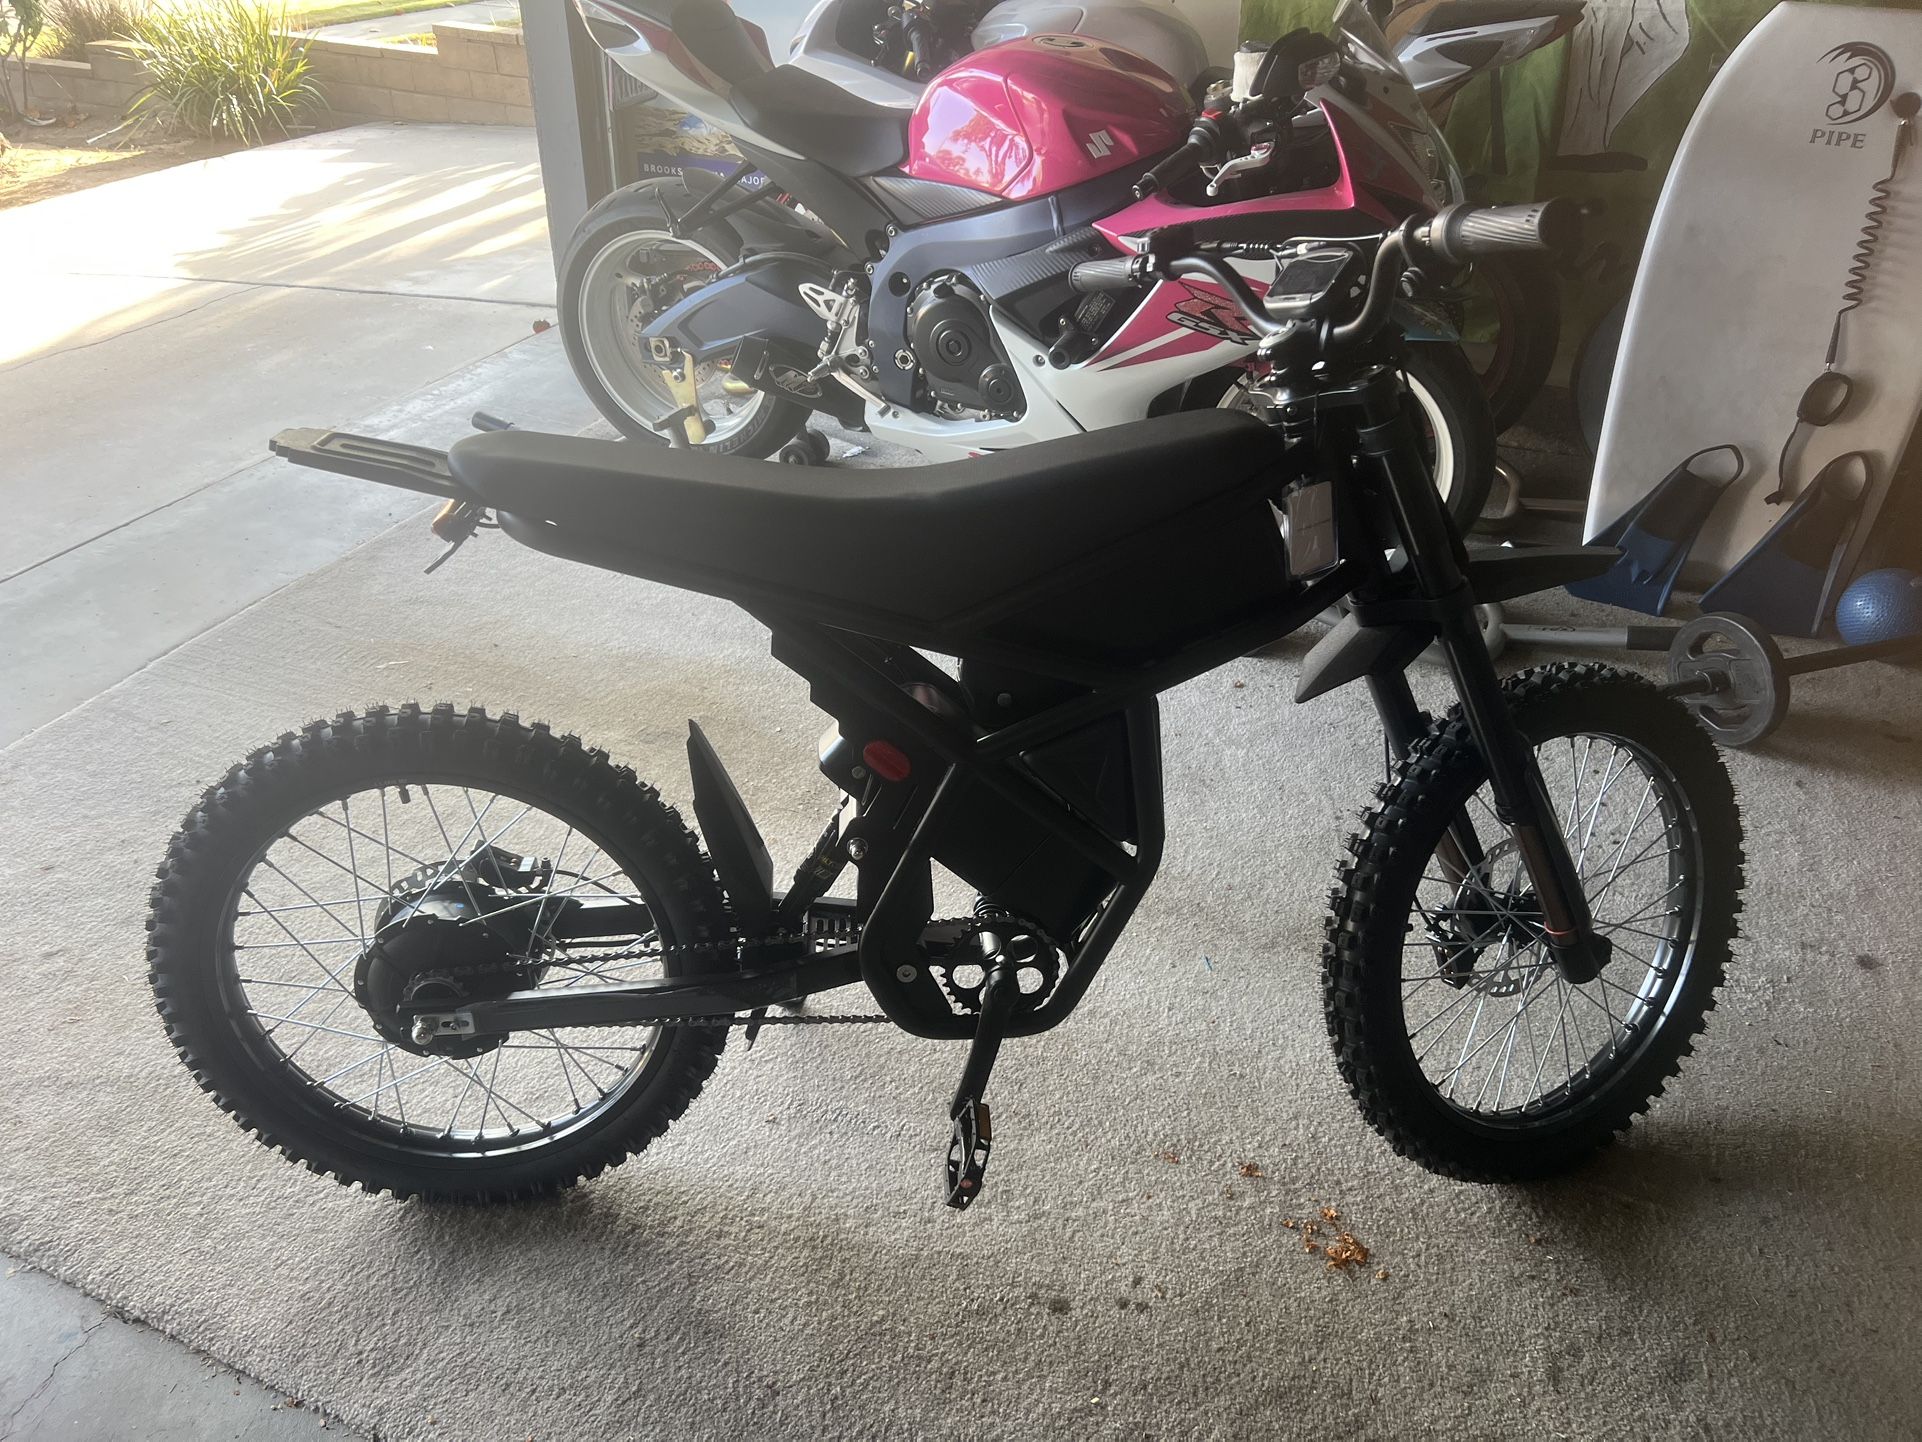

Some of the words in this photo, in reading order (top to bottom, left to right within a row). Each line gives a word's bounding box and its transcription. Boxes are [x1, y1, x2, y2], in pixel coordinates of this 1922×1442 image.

[1809, 128, 1867, 149] PIPE
[643, 163, 683, 176] BROOKS
[1166, 311, 1255, 346] GSX
